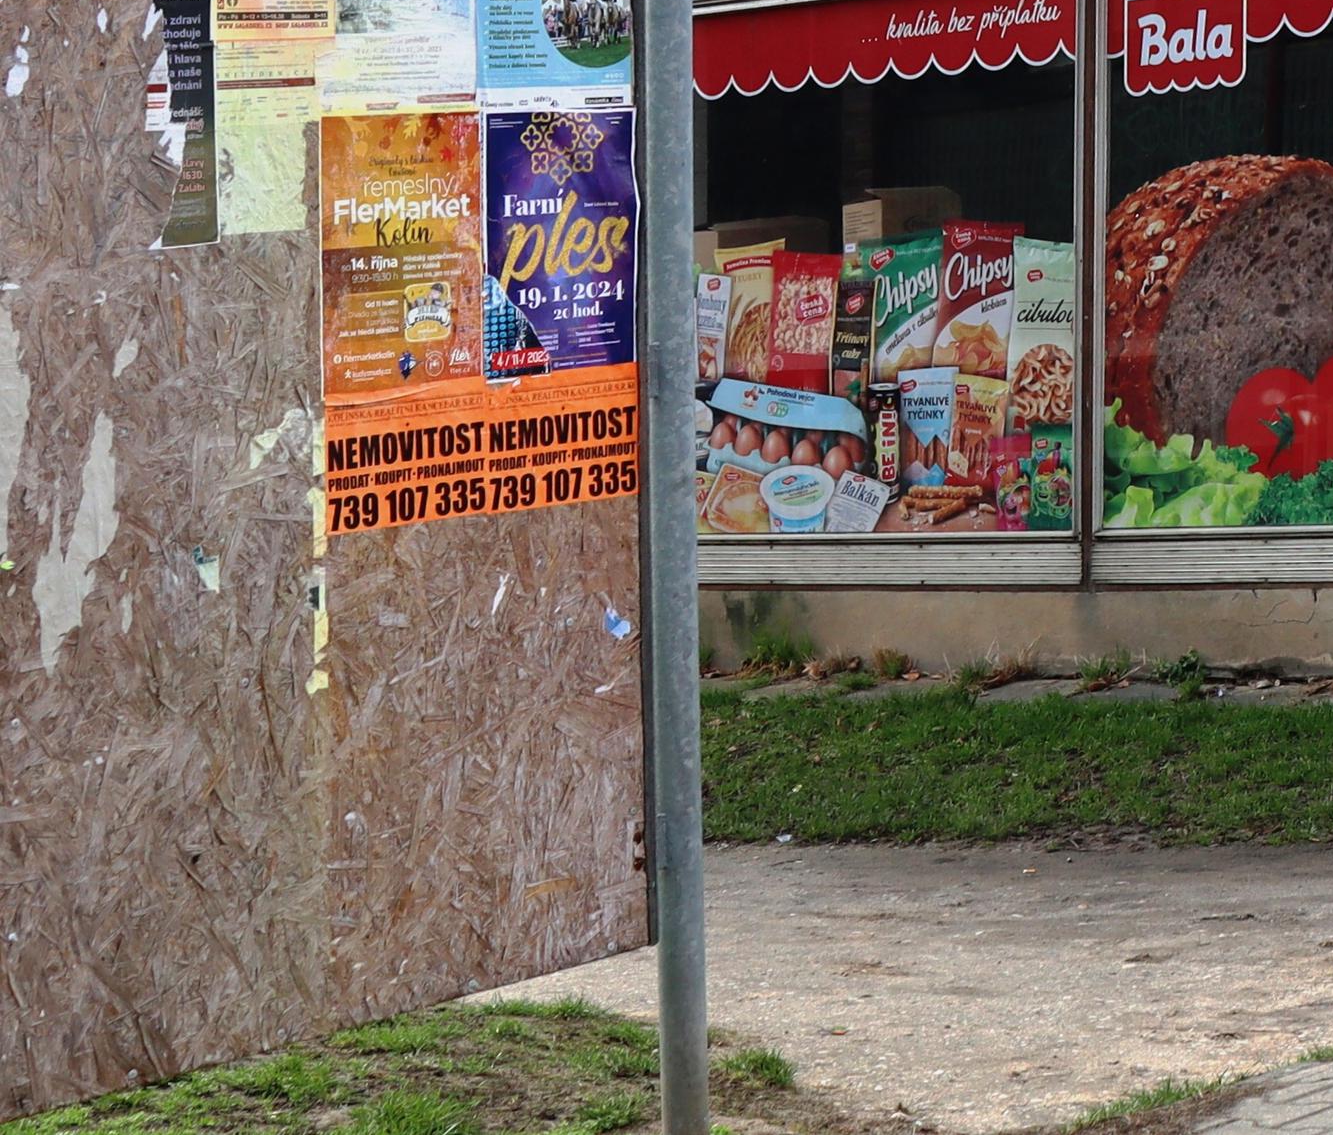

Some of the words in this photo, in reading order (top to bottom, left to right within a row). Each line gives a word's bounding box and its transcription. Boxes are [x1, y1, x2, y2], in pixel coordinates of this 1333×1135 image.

[170, 14, 201, 25] zdraví
[886, 10, 945, 41] kvalita
[947, 7, 975, 33] bez
[1137, 9, 1234, 66] Bala
[174, 54, 201, 64] hlava
[177, 68, 202, 78] naše
[363, 172, 455, 198] řemeslný
[333, 193, 471, 225] FlerMarket
[502, 188, 564, 218] Farní
[374, 217, 434, 249] Kolín
[500, 191, 630, 292] ples
[351, 257, 368, 270] 14.
[371, 256, 398, 272] října
[944, 252, 1013, 301] Chipsy
[517, 287, 547, 309] 19.
[552, 285, 568, 302] 1.
[572, 279, 625, 301] 2024
[874, 263, 938, 327] Chipsy
[572, 301, 604, 318] hod.
[803, 308, 823, 317] cena
[903, 393, 949, 407] TRVANLIVÉ
[907, 407, 945, 420] TYČINKY
[957, 399, 998, 414] TRVANLIVÉ
[489, 405, 637, 453] NEMOVITOST
[328, 421, 485, 472] NEMOVITOST
[489, 455, 528, 472] PRODAT
[532, 449, 567, 467] KOUPIT
[571, 441, 637, 462] PRONAJMOUT
[328, 473, 370, 492] PRODAT
[375, 467, 412, 486] KOUPIT
[417, 458, 485, 479] PRONAJMOUT
[489, 473, 536, 510] 739
[542, 467, 583, 503] 107
[588, 460, 637, 497] 335
[328, 492, 379, 532] 739
[385, 485, 429, 523] 107
[435, 477, 486, 517] 335
[841, 480, 880, 507] Balkán
